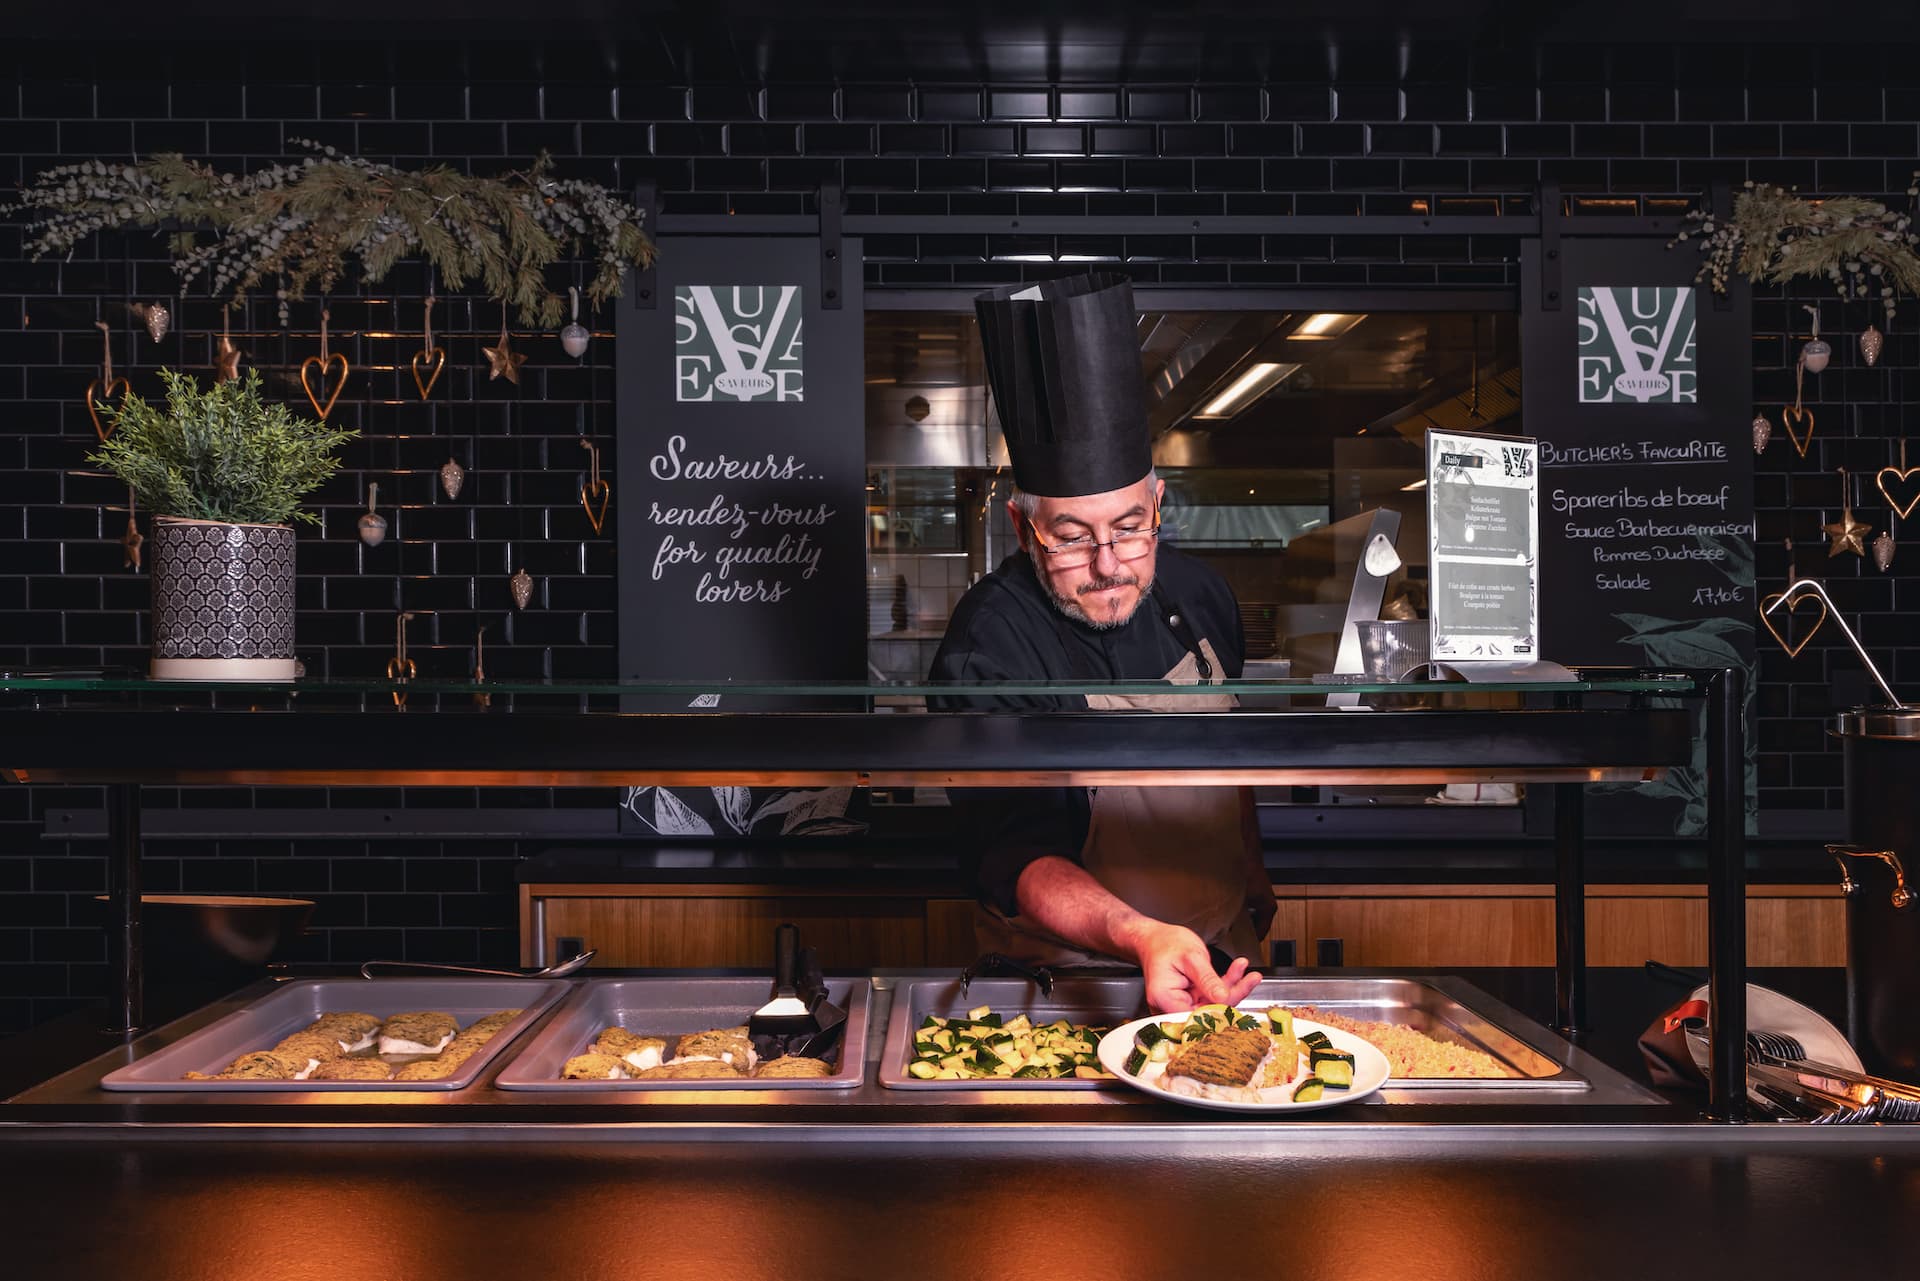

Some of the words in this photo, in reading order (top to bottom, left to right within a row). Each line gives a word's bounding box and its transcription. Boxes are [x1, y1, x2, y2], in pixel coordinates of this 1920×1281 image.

[718, 378, 772, 389] SAVEURS
[1618, 379, 1668, 390] SAVEURS
[650, 435, 824, 481] Saveurs...
[1445, 455, 1461, 466] Daily
[1552, 487, 1648, 516] Spareribs
[1651, 489, 1673, 508] de
[648, 494, 836, 539] rendez-vous
[1565, 522, 1615, 539] Sauce
[652, 535, 707, 580] for
[715, 533, 822, 580] quality
[1593, 547, 1651, 563] Pommes
[1651, 545, 1725, 561] Duchesse
[695, 572, 791, 602] lovers
[1596, 573, 1652, 590] Salade
